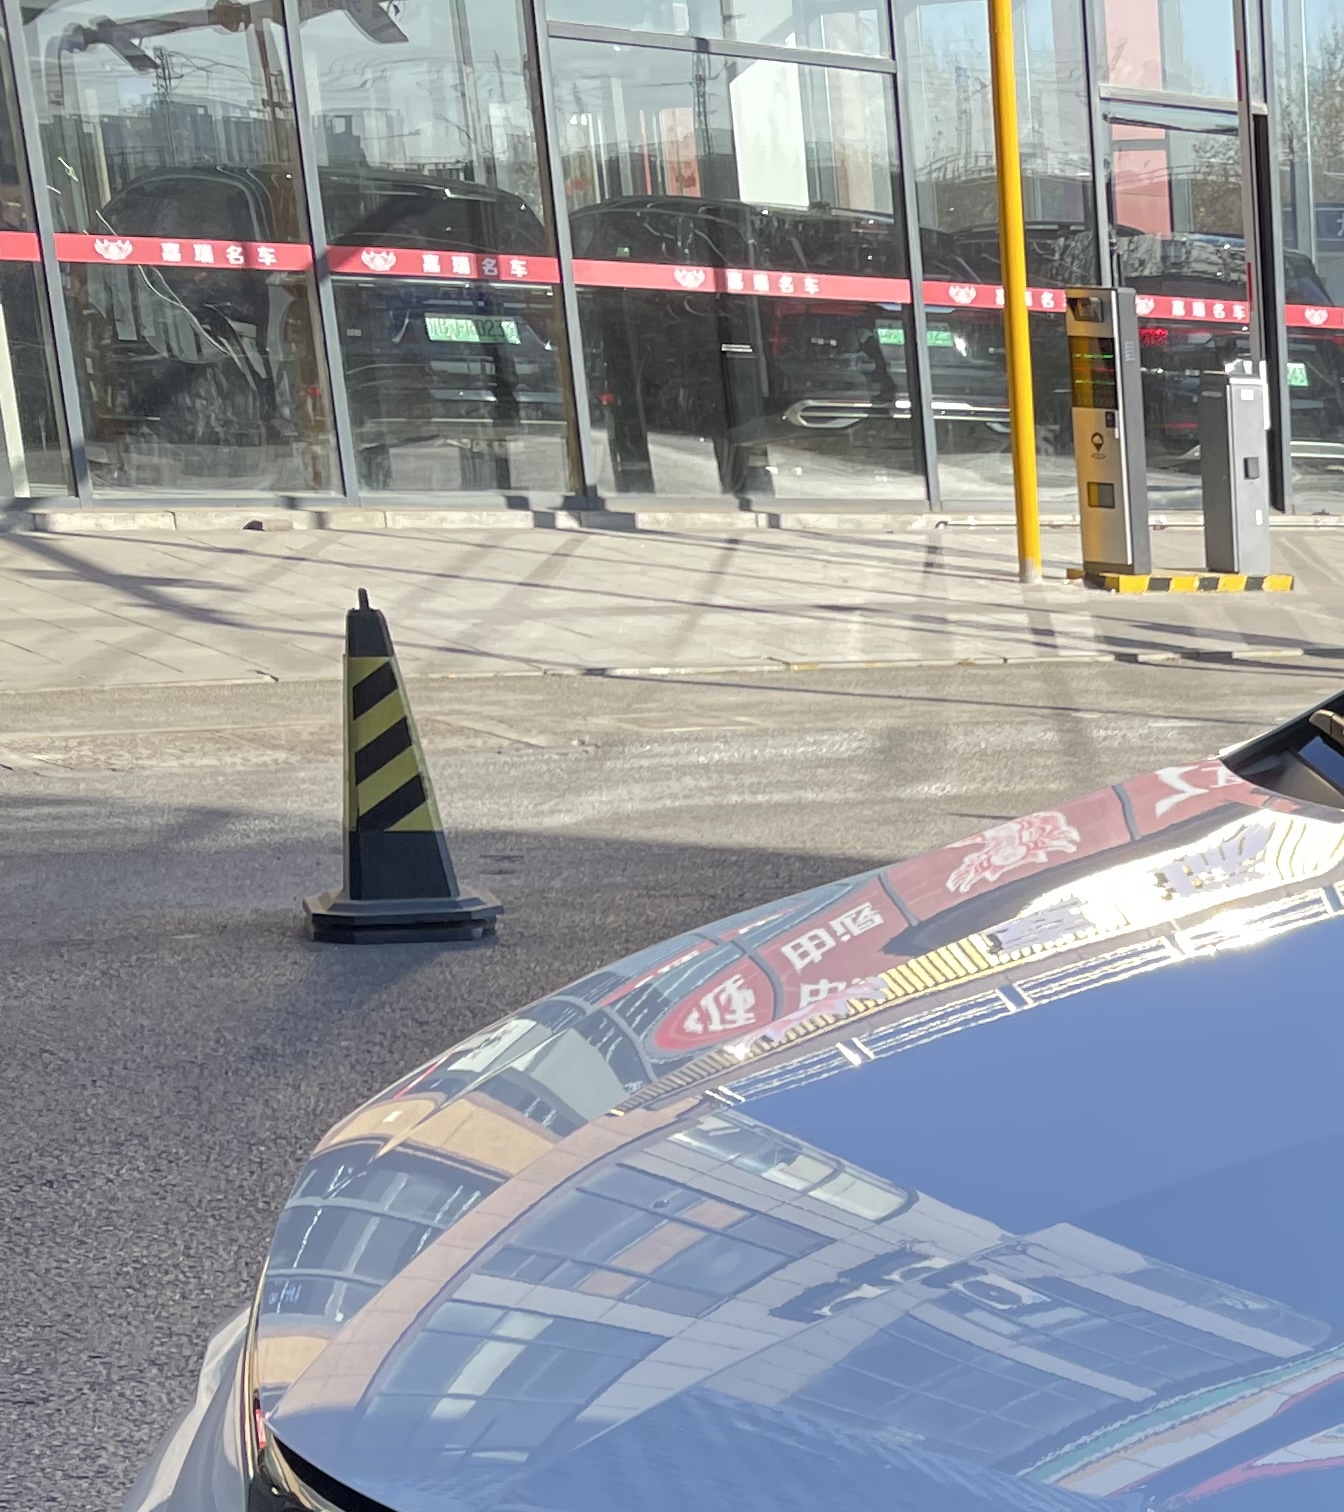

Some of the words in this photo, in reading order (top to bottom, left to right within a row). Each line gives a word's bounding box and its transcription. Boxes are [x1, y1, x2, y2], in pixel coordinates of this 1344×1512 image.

[160, 242, 278, 266] 嘉瑞名车
[422, 253, 528, 278] 嘉瑞名车
[726, 271, 820, 295] 嘉瑞名车
